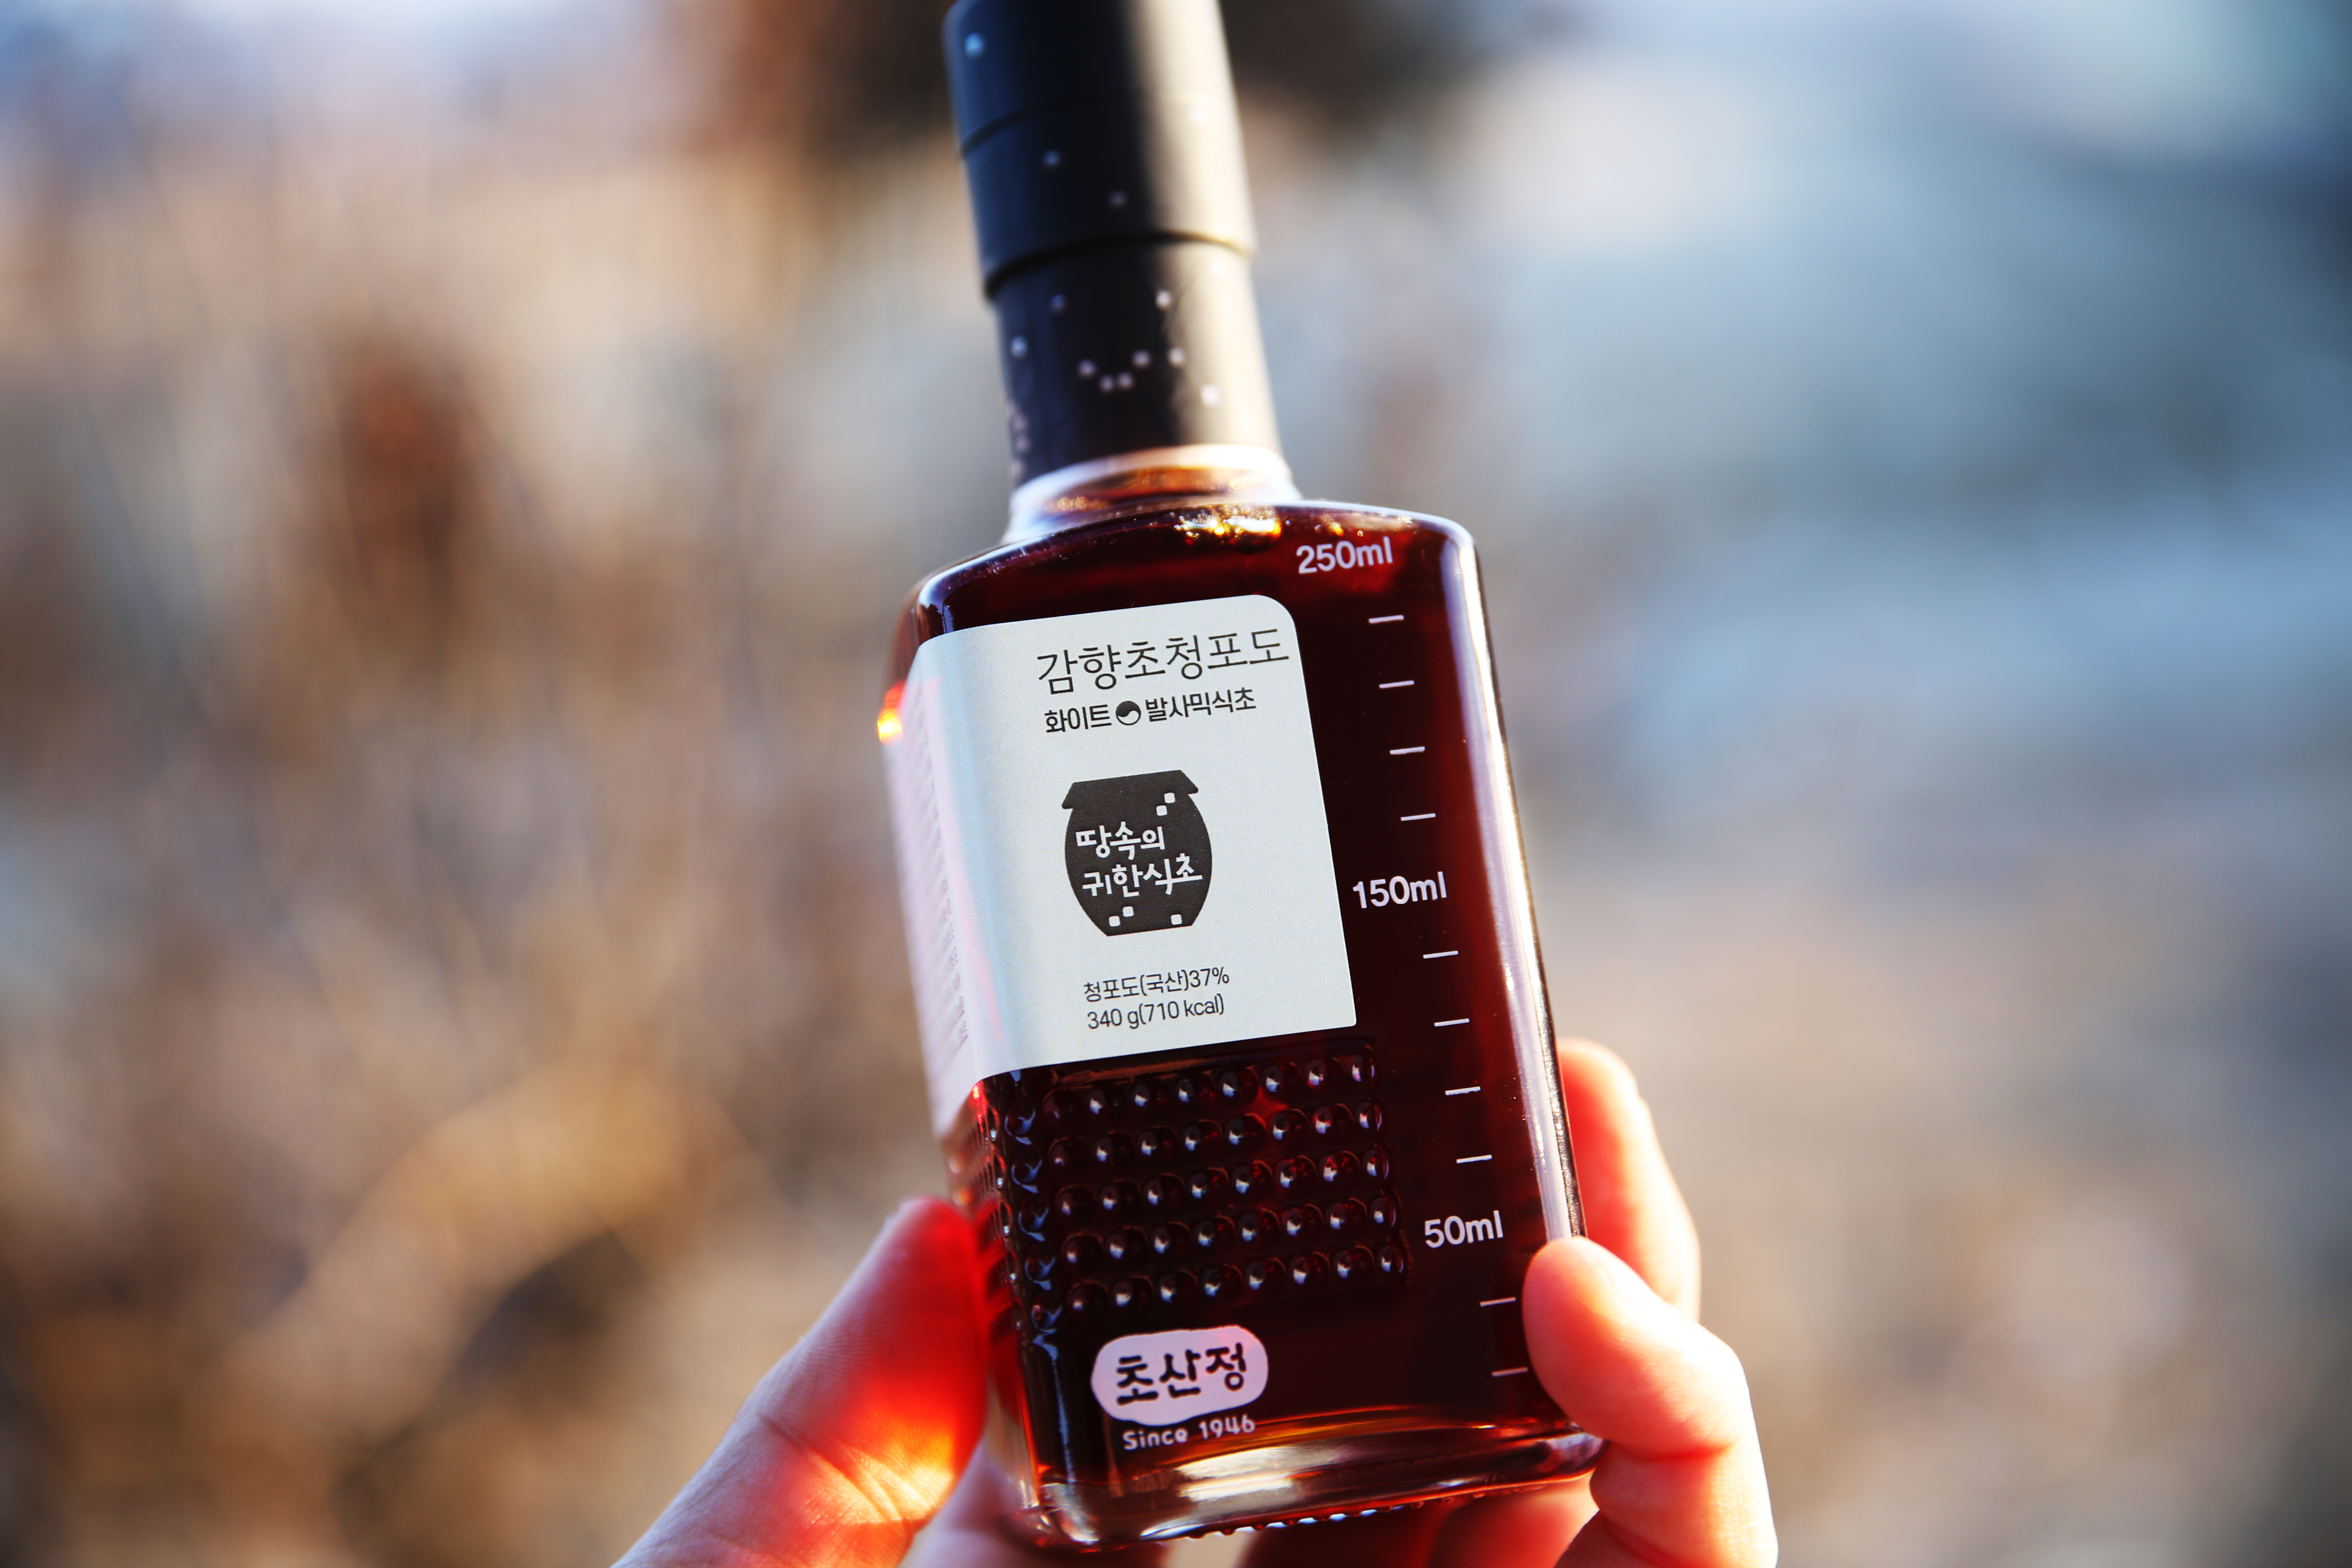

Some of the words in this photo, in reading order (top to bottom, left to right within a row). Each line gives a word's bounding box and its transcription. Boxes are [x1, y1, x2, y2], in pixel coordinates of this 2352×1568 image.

[1296, 536, 1393, 574] 250ml
[1037, 629, 1289, 694] 감향초청포도
[1044, 704, 1112, 733] 화이트
[1145, 687, 1256, 722] 발사믹식초
[1076, 821, 1165, 860] 땅속의
[1082, 853, 1203, 897] 귀한식초
[1352, 871, 1447, 909] 150ml
[1084, 967, 1229, 1002] 청포도(국산)37%
[1087, 1009, 1122, 1029] 340
[1184, 993, 1224, 1017] kcal)
[1425, 1210, 1503, 1249] 50ml
[1116, 1342, 1247, 1405] 초산정
[1123, 1428, 1188, 1450] Since
[1199, 1414, 1256, 1439] 1946
